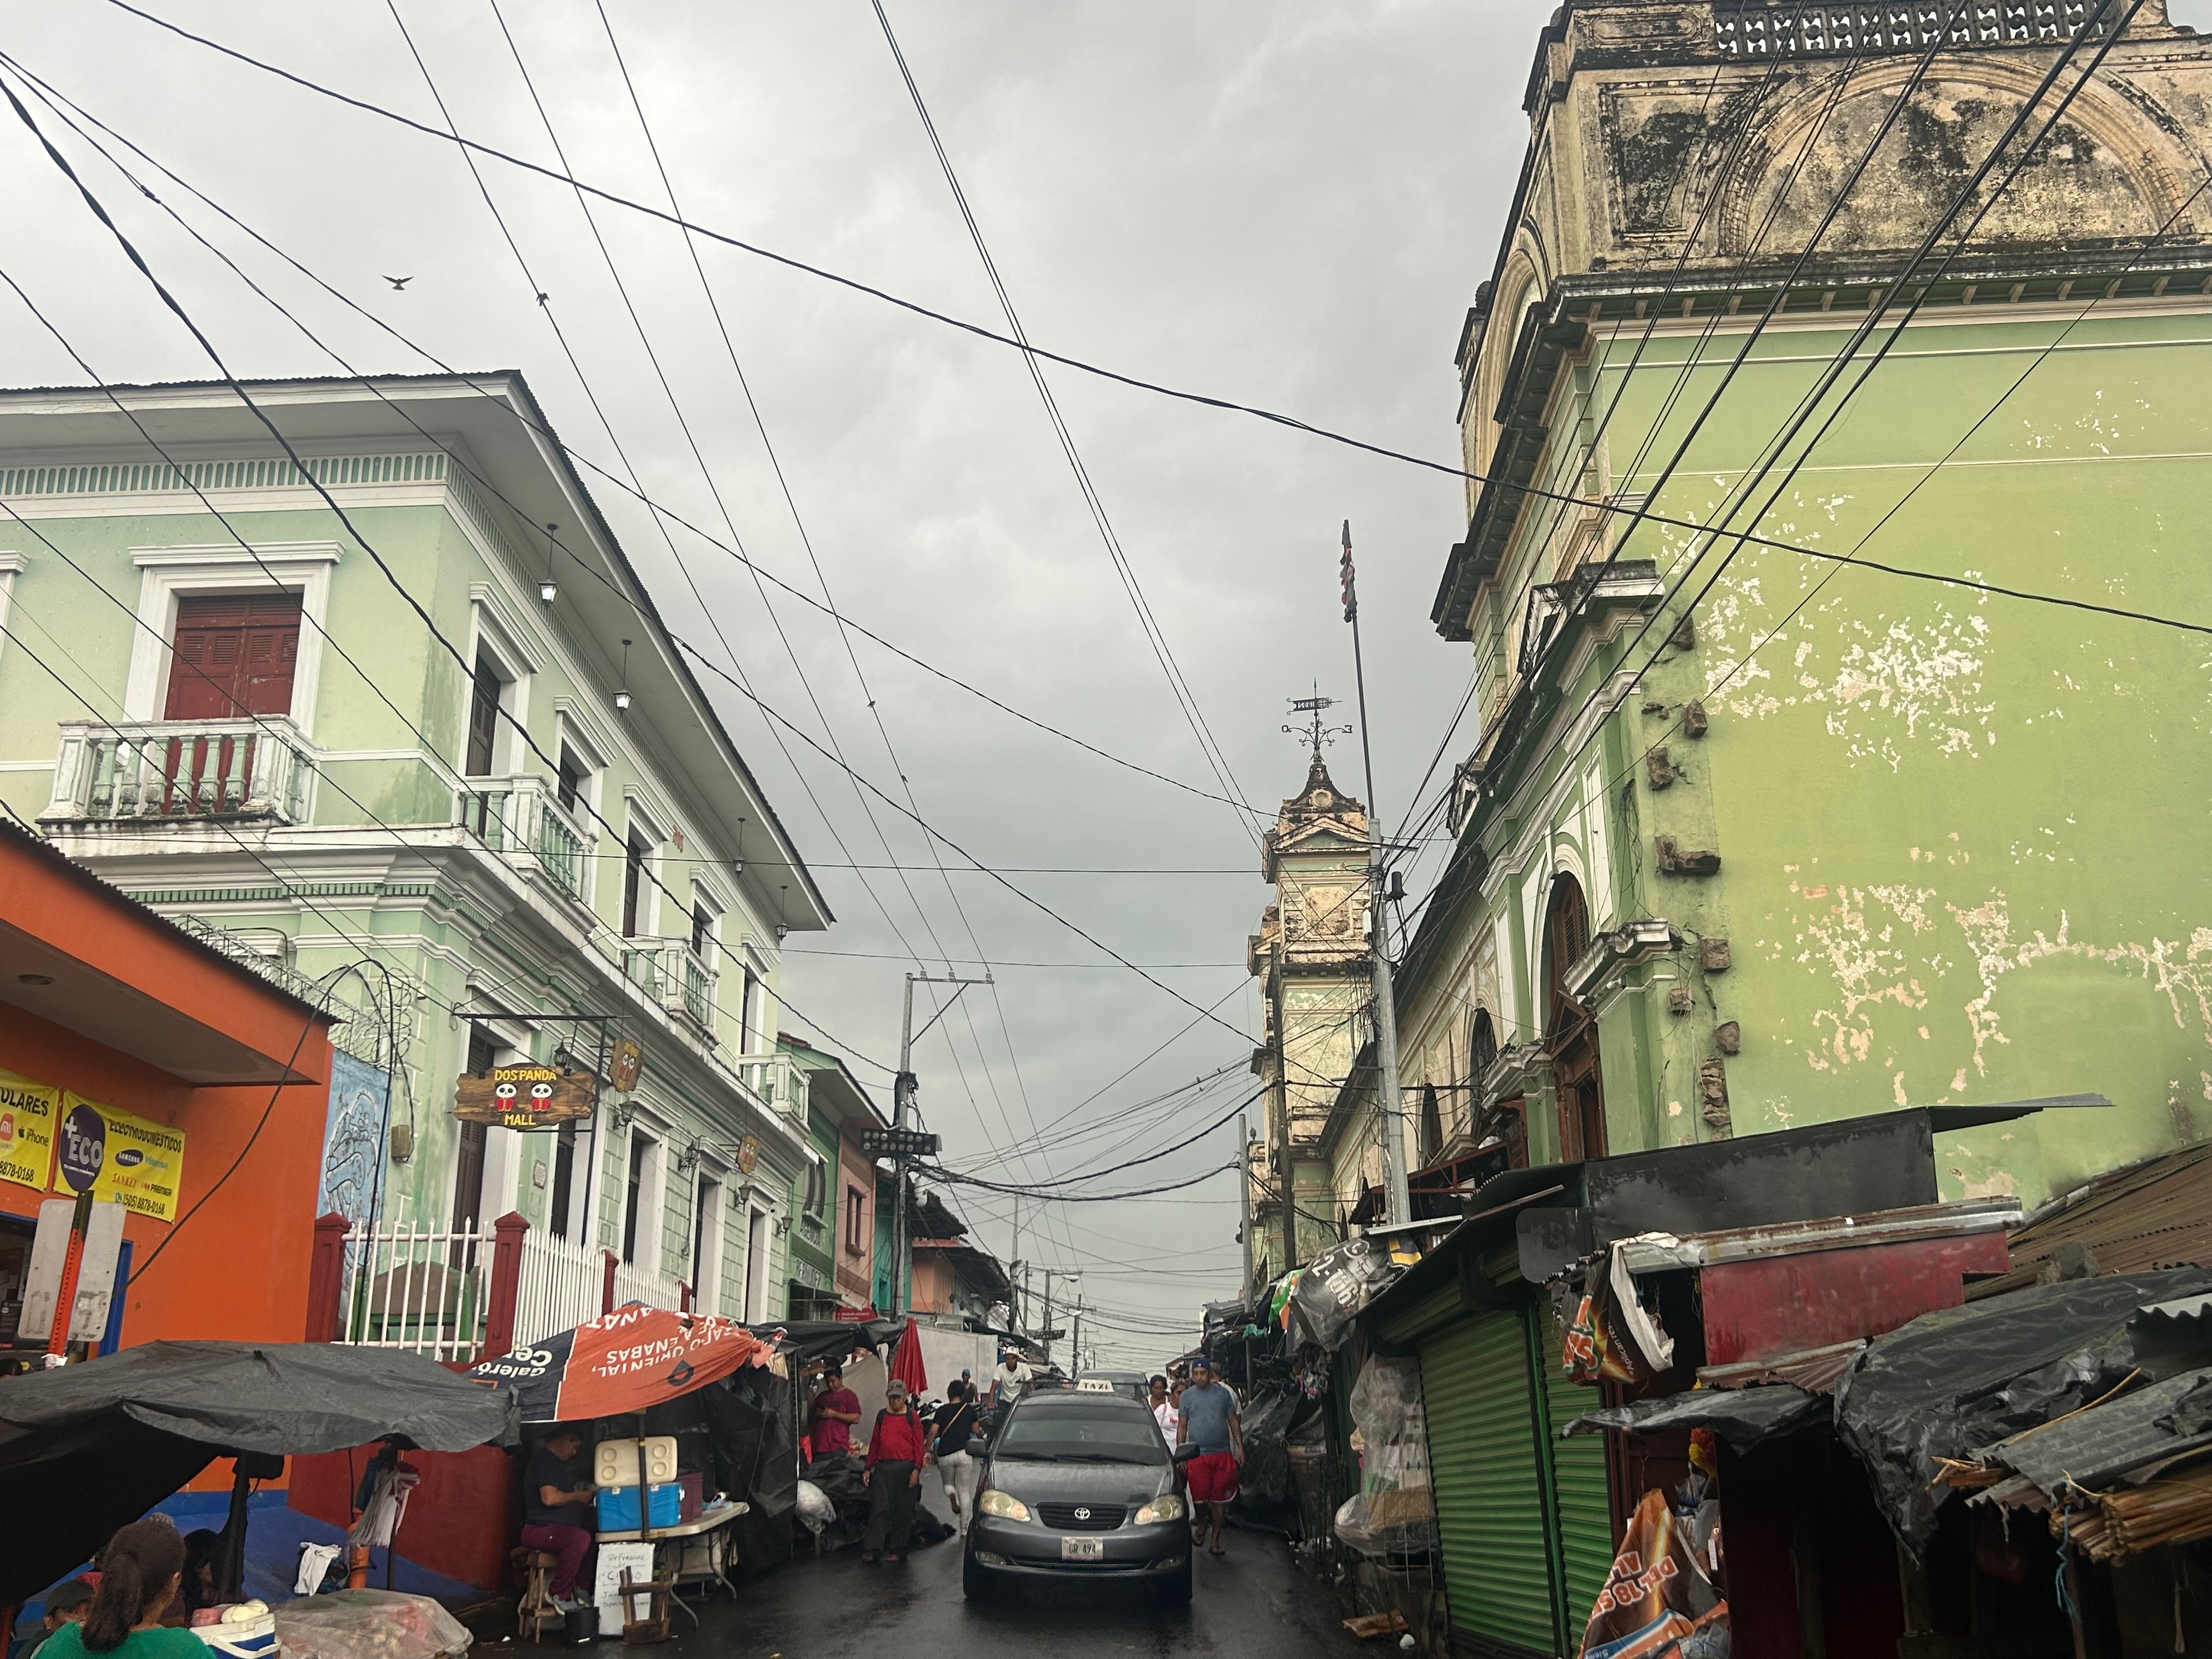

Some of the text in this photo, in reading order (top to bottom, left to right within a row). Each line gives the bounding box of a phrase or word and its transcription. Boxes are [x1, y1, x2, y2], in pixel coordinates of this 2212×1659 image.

[505, 1114, 536, 1125] MALL
[26, 1127, 49, 1147] iPhone
[145, 1155, 168, 1169] Hisense
[112, 1173, 172, 1197] SANKEY PREMIER
[137, 1198, 165, 1215] 8878-0168
[606, 1336, 679, 1364] ENABAS
[1638, 1555, 1679, 1593] DEL
[1612, 1579, 1645, 1606] 18
